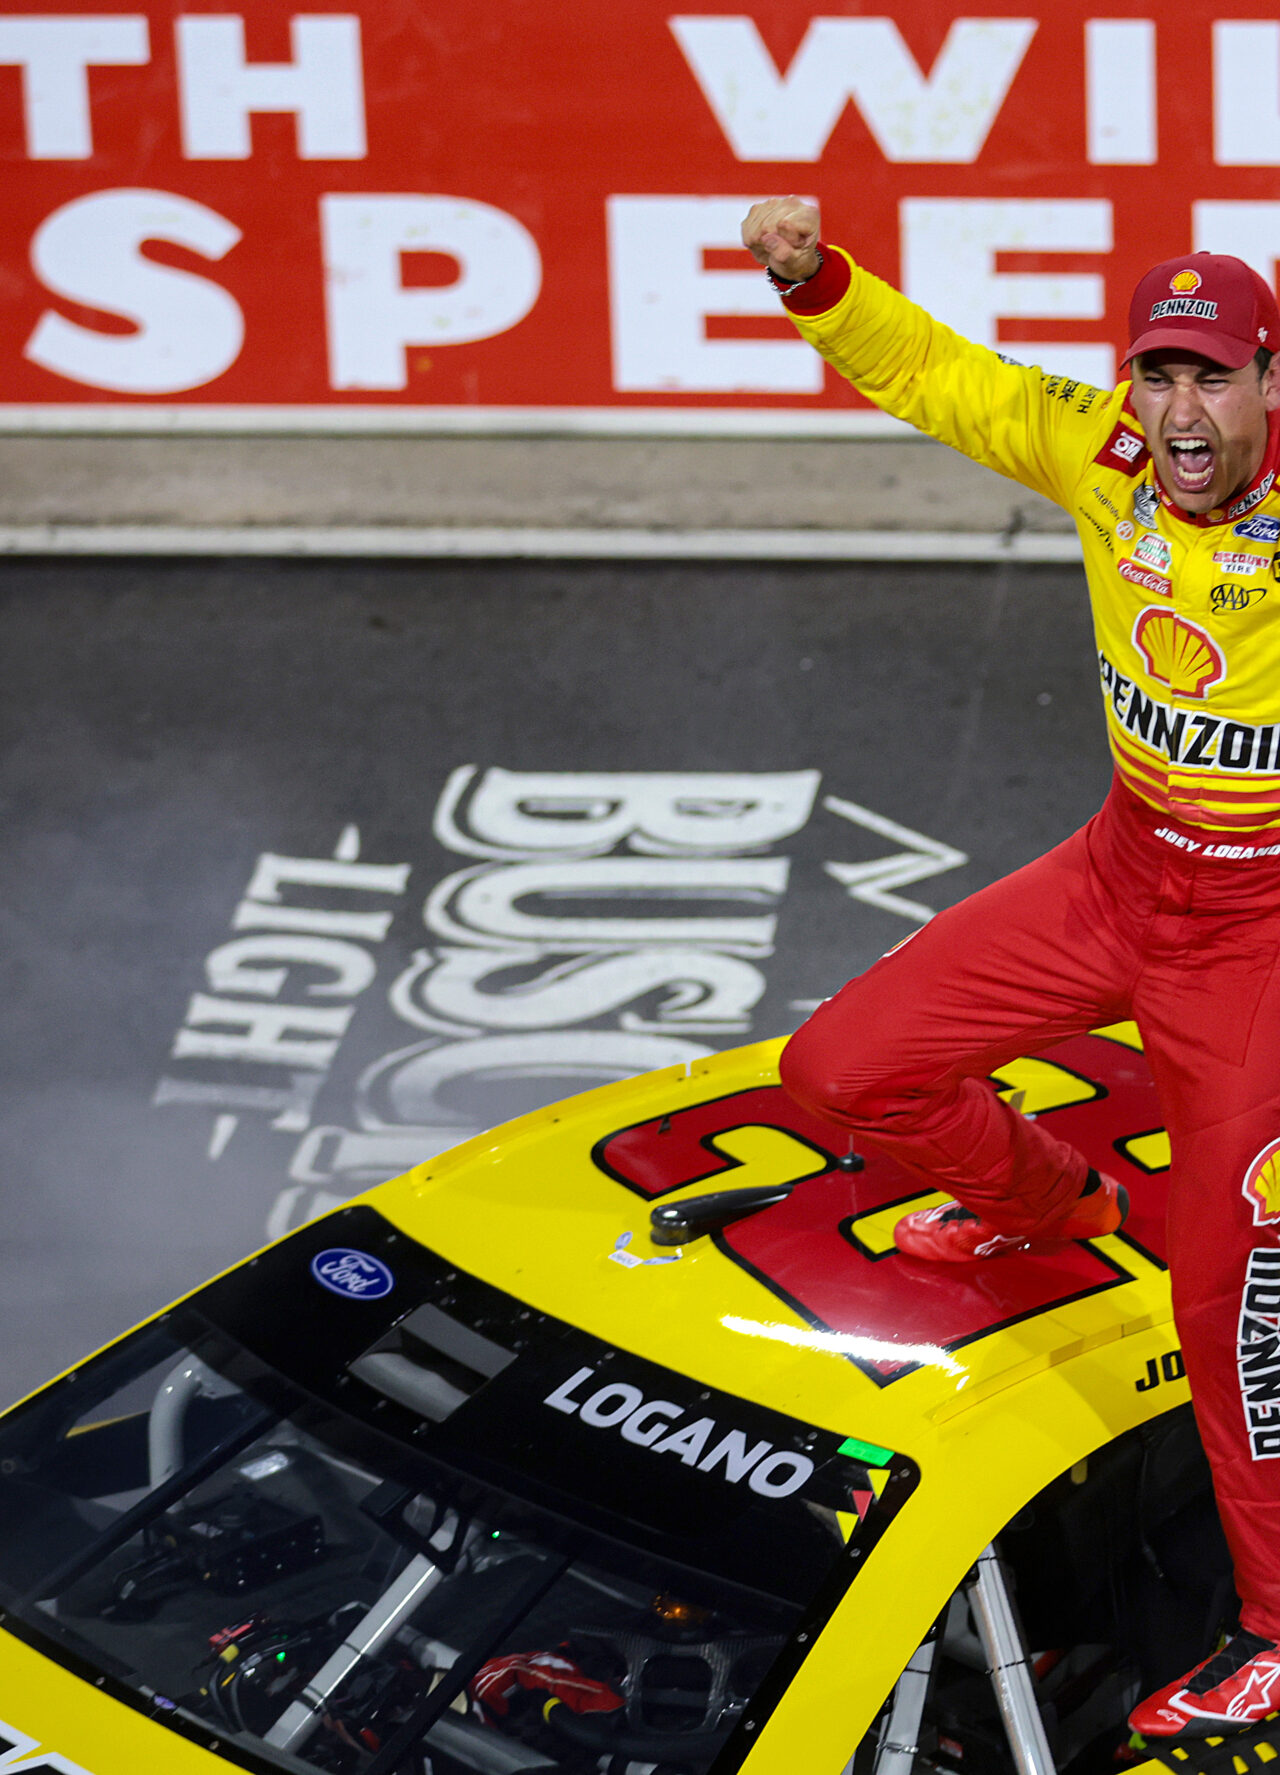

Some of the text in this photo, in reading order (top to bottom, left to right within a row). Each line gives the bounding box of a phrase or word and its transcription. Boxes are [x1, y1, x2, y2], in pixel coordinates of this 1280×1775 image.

[1149, 298, 1219, 322] PENNZOIL
[1240, 518, 1280, 540] Ford
[1154, 825, 1202, 853] JOEY
[154, 851, 412, 1132] LIGHT
[320, 1253, 382, 1293] Ford
[543, 1366, 815, 1499] LOGANO
